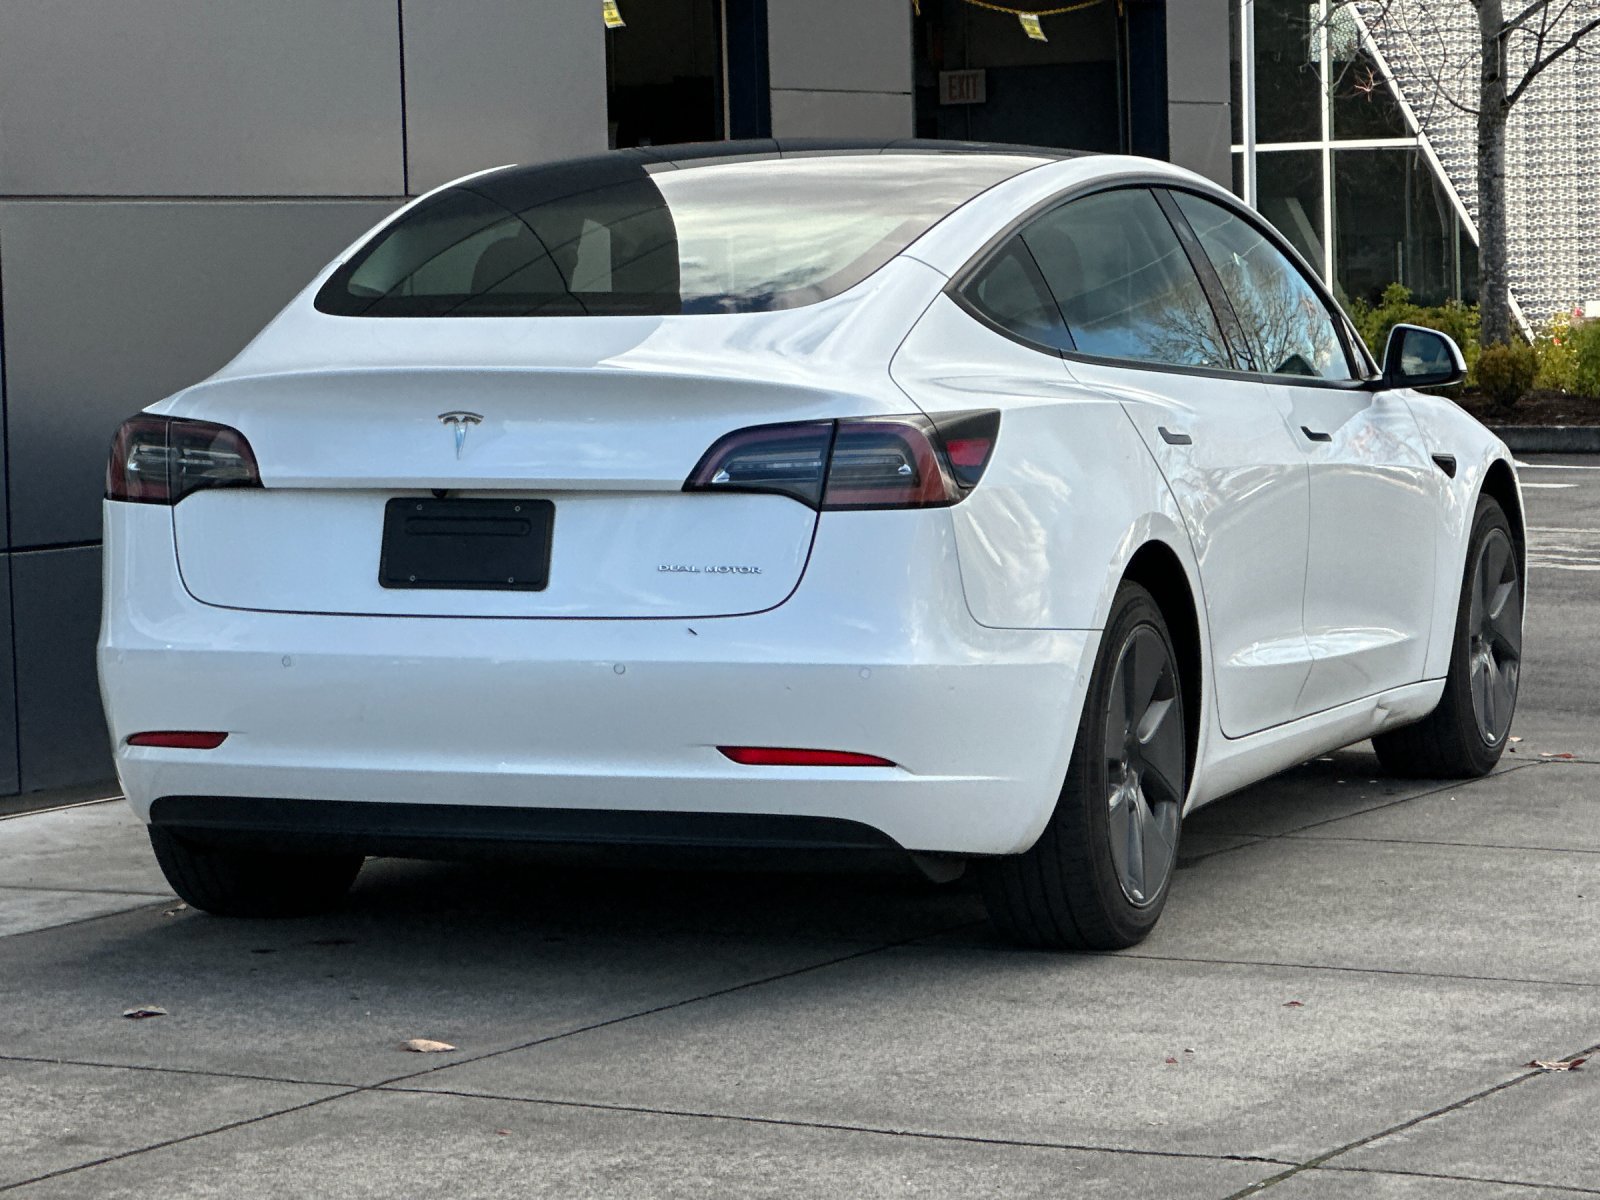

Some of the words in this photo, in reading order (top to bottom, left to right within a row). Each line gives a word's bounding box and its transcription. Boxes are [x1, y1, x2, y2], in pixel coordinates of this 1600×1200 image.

[948, 74, 979, 99] EXIT
[657, 564, 701, 573] DUAL
[705, 565, 763, 575] MOTOR
